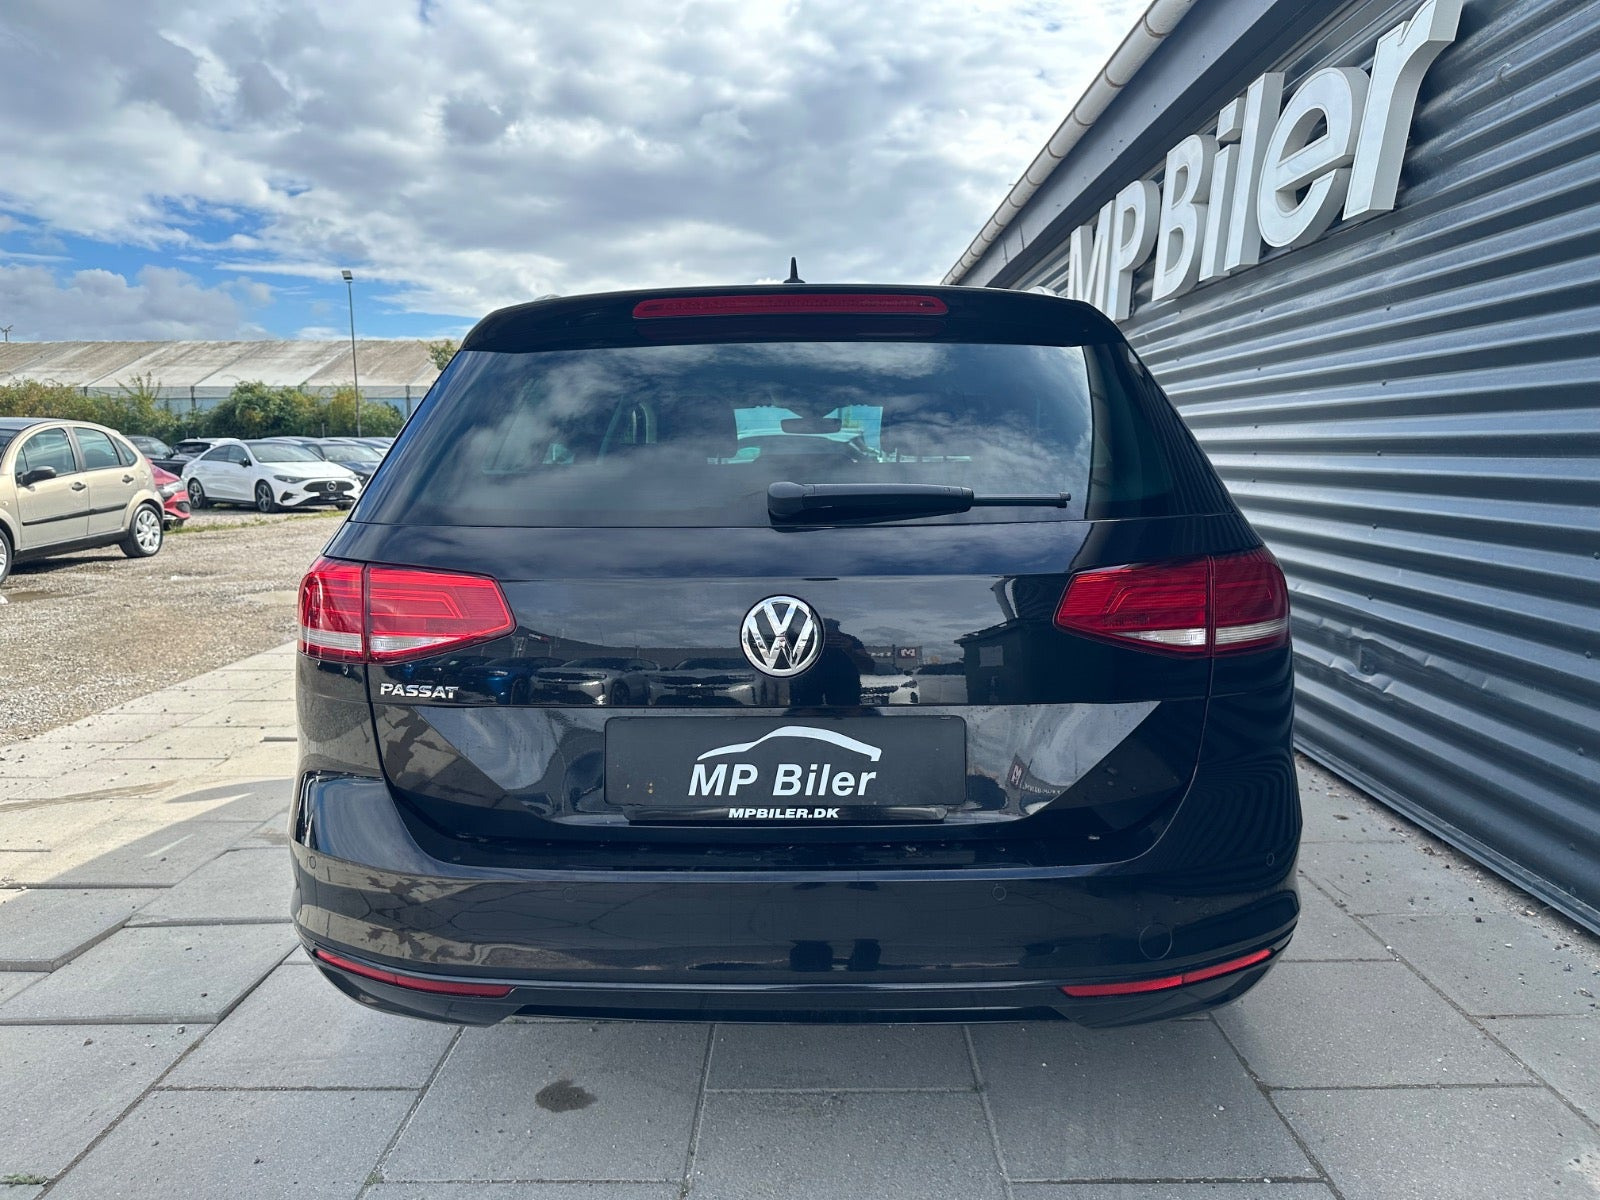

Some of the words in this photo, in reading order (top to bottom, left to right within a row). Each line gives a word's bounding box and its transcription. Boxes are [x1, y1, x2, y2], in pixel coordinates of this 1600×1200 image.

[1067, 179, 1160, 321] MP
[1152, 0, 1464, 302] Biler
[380, 683, 459, 699] PASSAT
[688, 763, 758, 797] MP
[772, 763, 877, 797] Biler
[728, 807, 839, 819] MPBILER.DK
